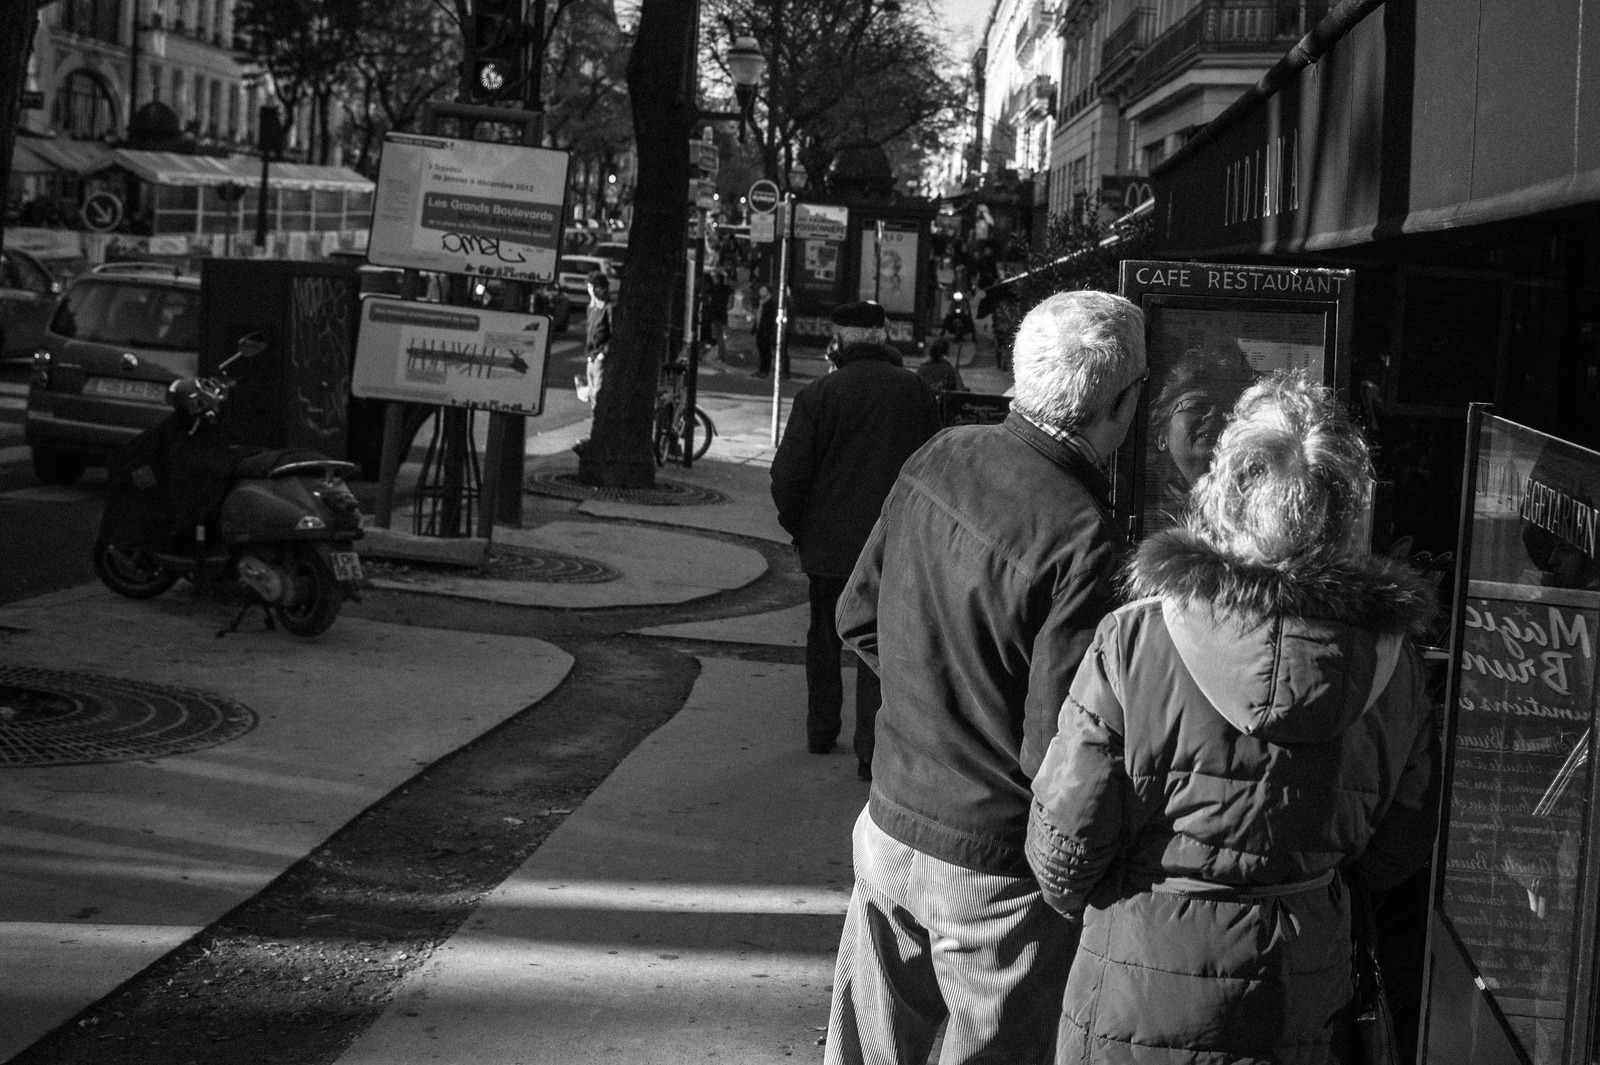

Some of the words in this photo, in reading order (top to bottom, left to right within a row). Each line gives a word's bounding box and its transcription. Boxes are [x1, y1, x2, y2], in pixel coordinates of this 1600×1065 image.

[515, 184, 535, 193] 2012
[427, 196, 448, 209] Les
[450, 198, 491, 215] Grands
[491, 204, 554, 222] Boulevards
[1135, 266, 1192, 289] CAFE
[1207, 270, 1347, 295] RESTAURANT
